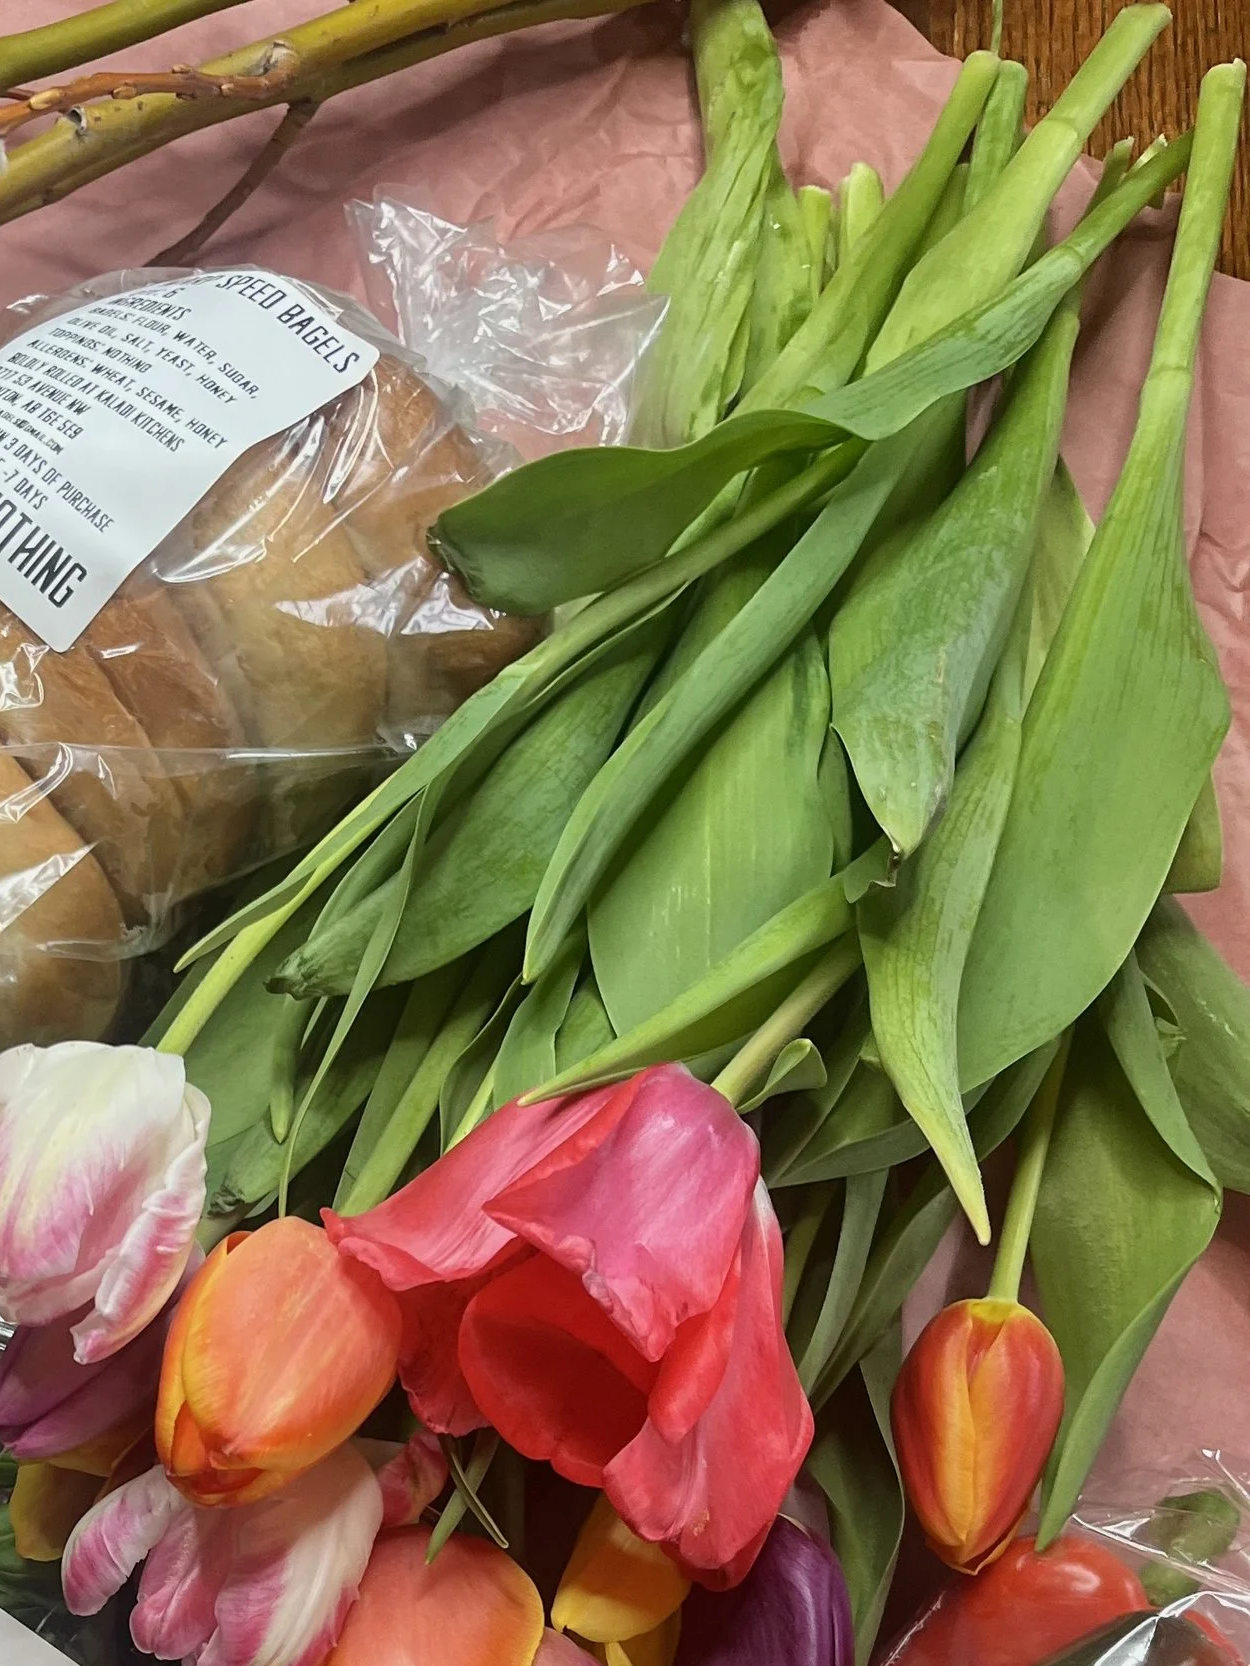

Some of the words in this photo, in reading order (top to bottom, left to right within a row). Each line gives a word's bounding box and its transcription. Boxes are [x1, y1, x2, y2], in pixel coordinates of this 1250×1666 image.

[49, 328, 104, 352] TOPPINGS:
[103, 347, 153, 373] NOTHING
[67, 317, 99, 331] OLIVE
[98, 324, 119, 340] OIL,
[121, 333, 156, 353] SALT,
[155, 347, 195, 376] YEAST,
[196, 373, 238, 404] HONEY
[133, 315, 171, 337] FLOUR,
[173, 331, 217, 365] WATER,
[218, 363, 260, 399] SUGAR,
[216, 275, 286, 310] SPEED
[277, 304, 360, 374] BAGELS
[7, 352, 46, 373] BOLDLY
[43, 365, 85, 388] ROLLED
[79, 378, 100, 395] AT
[94, 389, 137, 418] KALADI
[130, 412, 185, 452] KITCHENS
[12, 373, 34, 386] 53
[27, 381, 72, 405] AVENUE
[66, 399, 91, 415] NW
[20, 400, 43, 414] AB
[37, 407, 64, 427] T6E
[57, 419, 84, 439] 5E9
[27, 339, 93, 368] ALLERGENS:
[92, 364, 136, 393] WHEAT,
[135, 386, 185, 423] SESAME,
[185, 417, 229, 449] HONEY
[4, 438, 17, 450] 3
[13, 444, 48, 474] DAYS
[42, 467, 62, 486] OF
[56, 481, 115, 533] PURCHASE
[13, 478, 48, 510] DAYS
